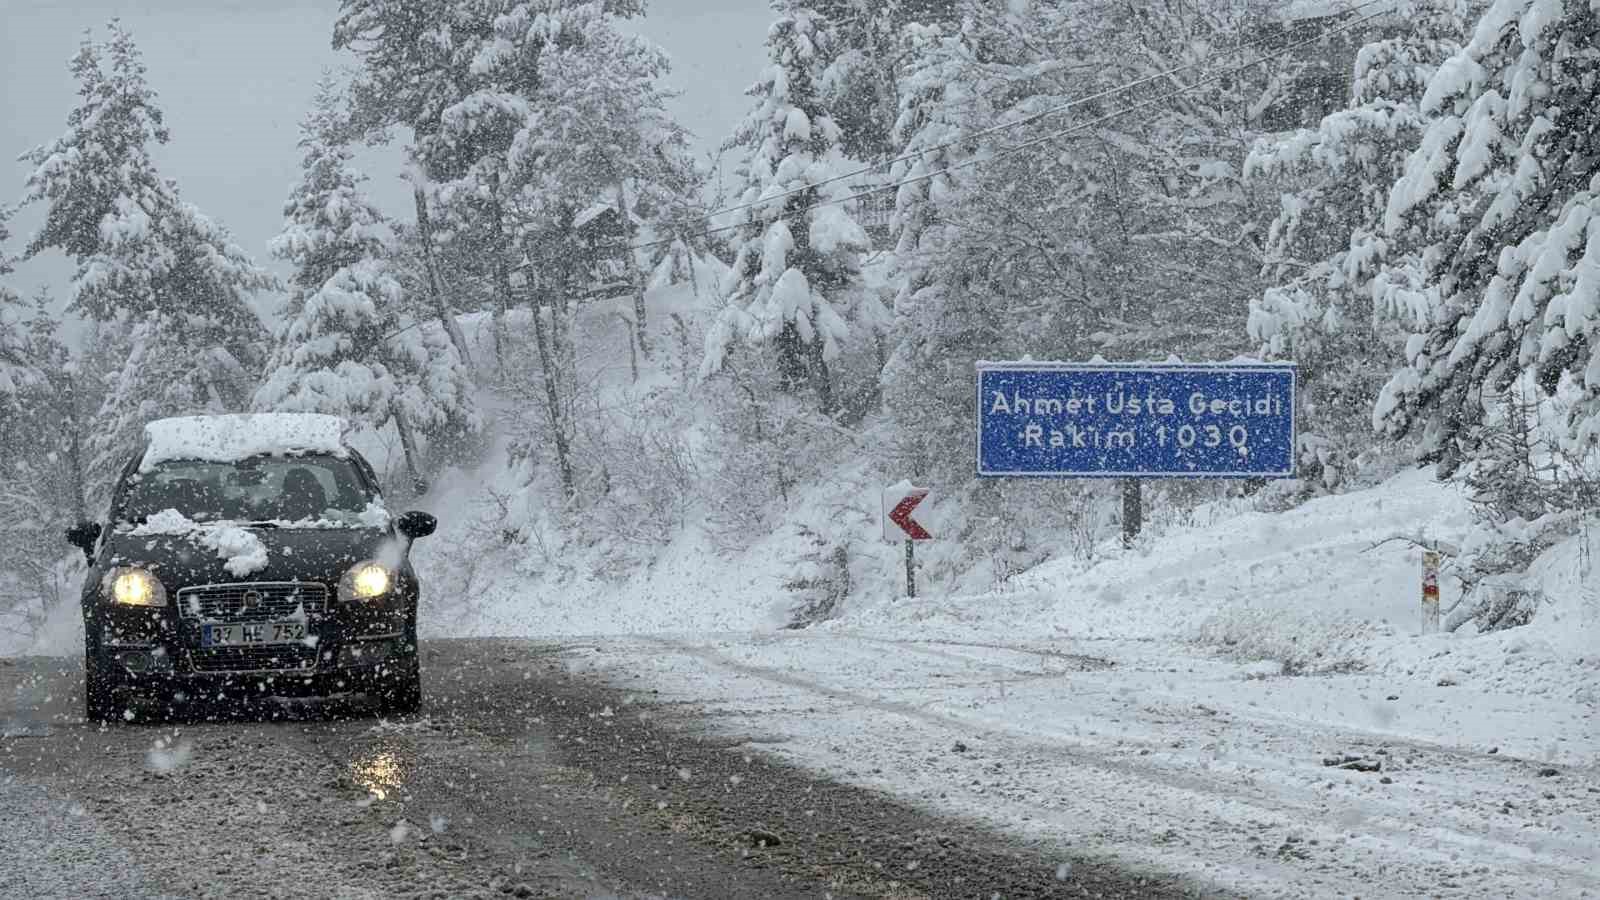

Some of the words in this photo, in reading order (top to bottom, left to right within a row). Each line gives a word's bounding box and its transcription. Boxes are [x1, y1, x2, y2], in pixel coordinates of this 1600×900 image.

[991, 390, 1096, 415] Ahmet
[1155, 425, 1248, 448] 1030
[213, 627, 232, 643] 37
[272, 624, 305, 641] 752
